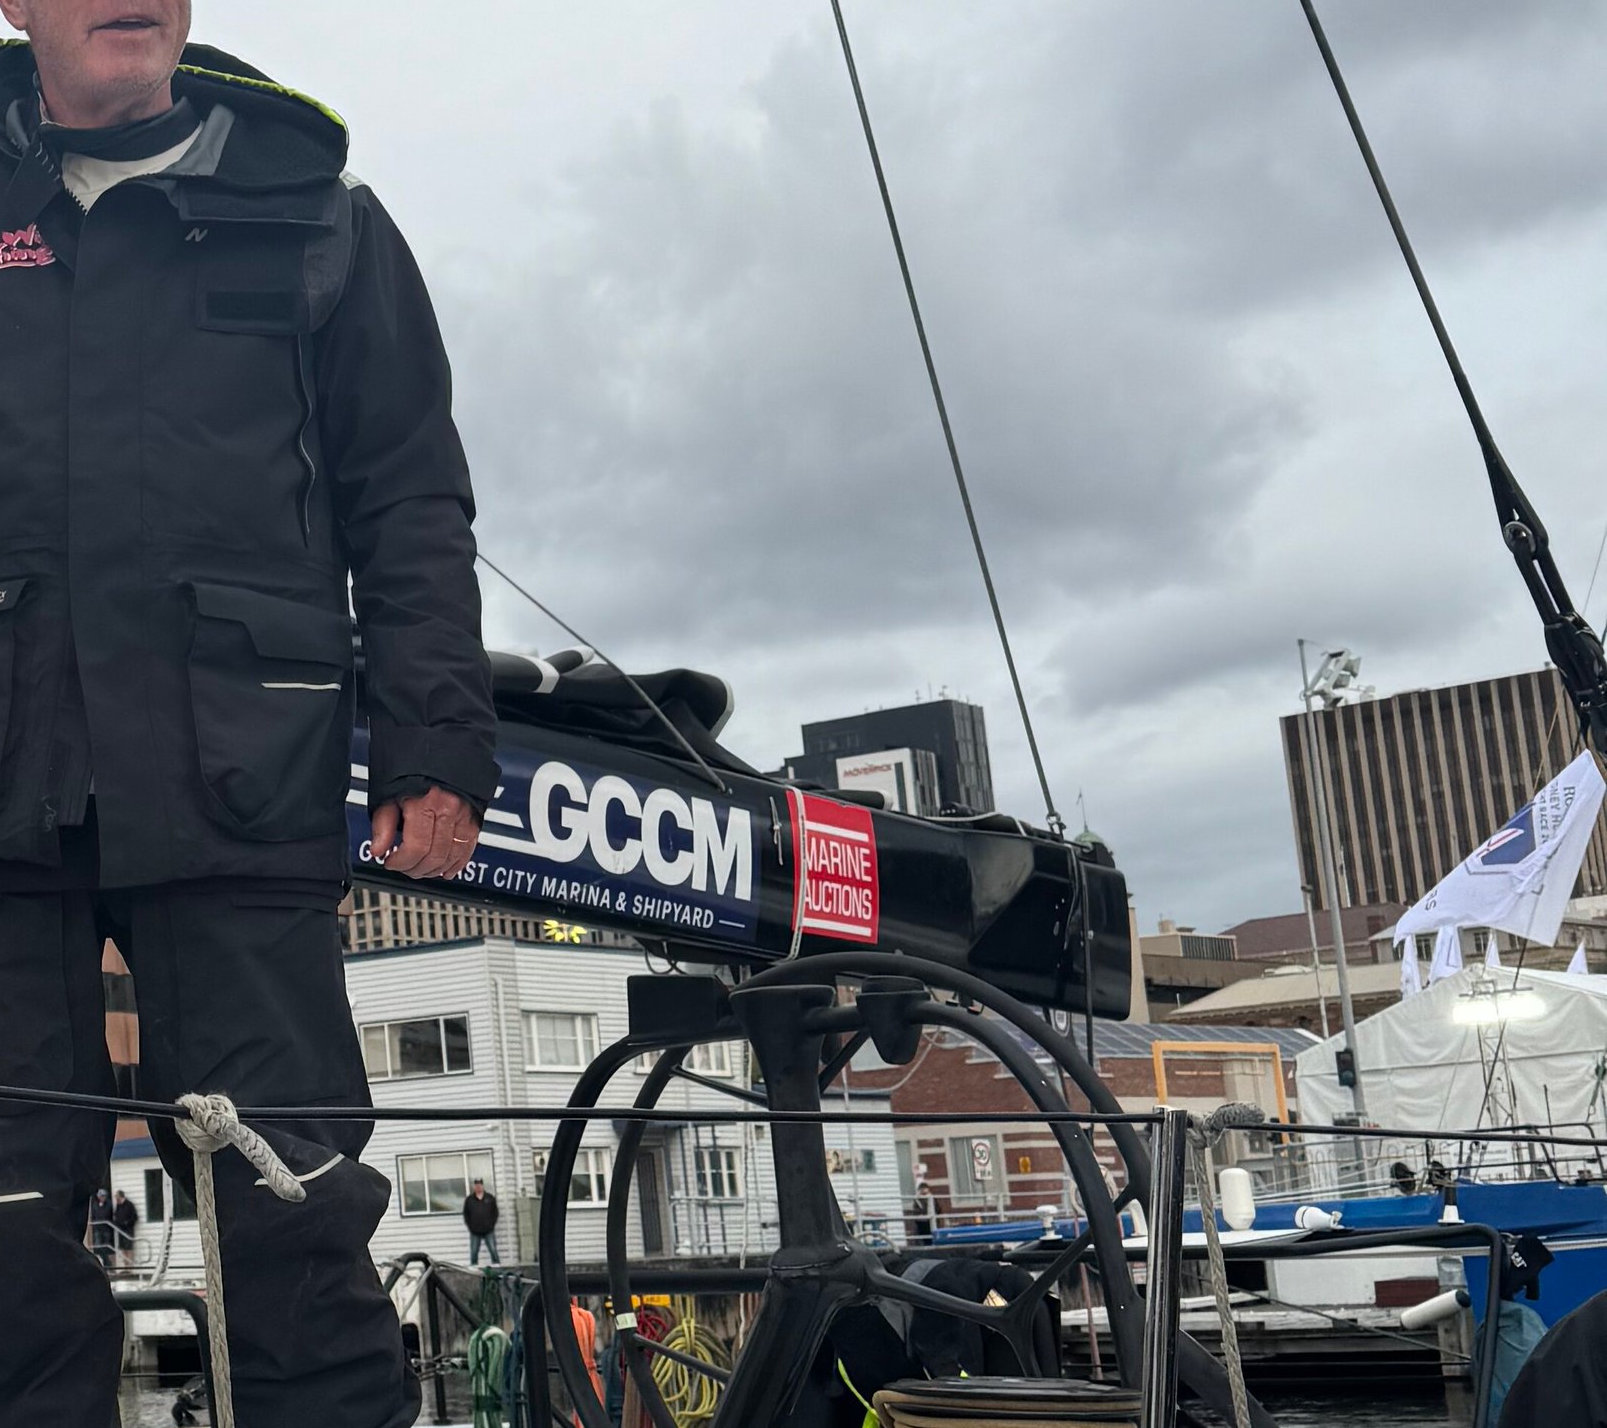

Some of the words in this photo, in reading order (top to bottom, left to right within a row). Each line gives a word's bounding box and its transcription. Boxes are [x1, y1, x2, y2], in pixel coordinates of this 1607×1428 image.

[530, 761, 752, 901] GCCM
[805, 836, 872, 882] MARINE
[493, 867, 536, 894] CITY
[541, 876, 610, 909] MARINA
[615, 891, 627, 912] &
[632, 894, 714, 929] SHIPYARD
[804, 878, 872, 920] AUCTIONS
